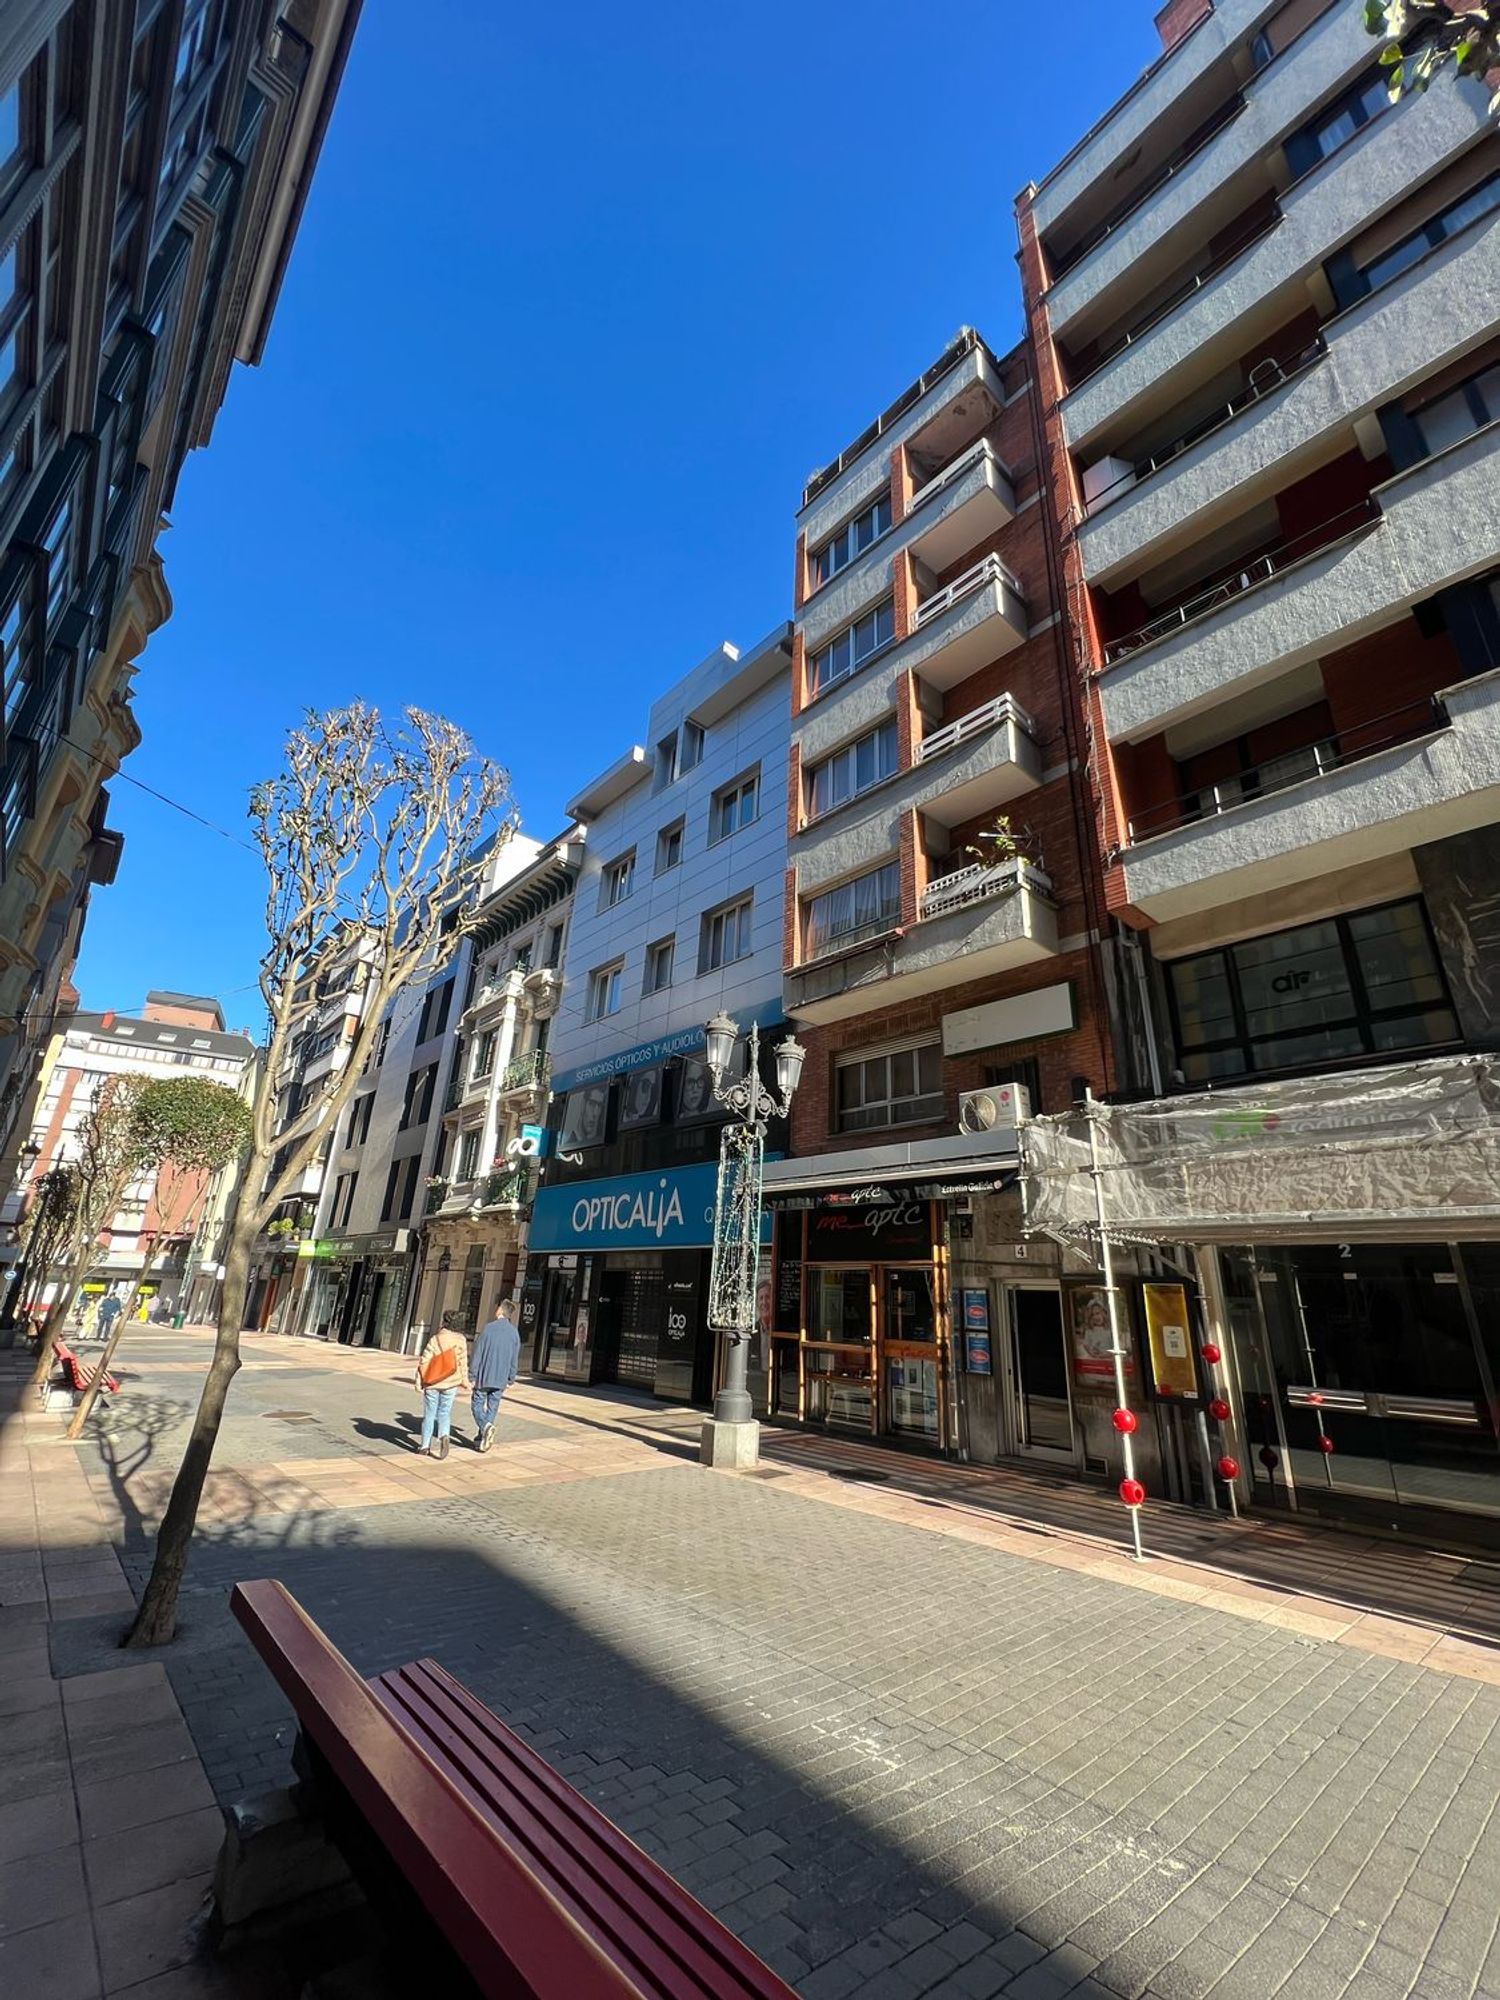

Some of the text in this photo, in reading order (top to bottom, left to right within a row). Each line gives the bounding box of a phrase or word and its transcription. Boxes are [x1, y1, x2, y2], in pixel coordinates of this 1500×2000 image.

[575, 1060, 615, 1082] SERVICIOS
[653, 1043, 661, 1058] Y
[1016, 1246, 1025, 1257] 4
[1338, 1243, 1353, 1259] 2
